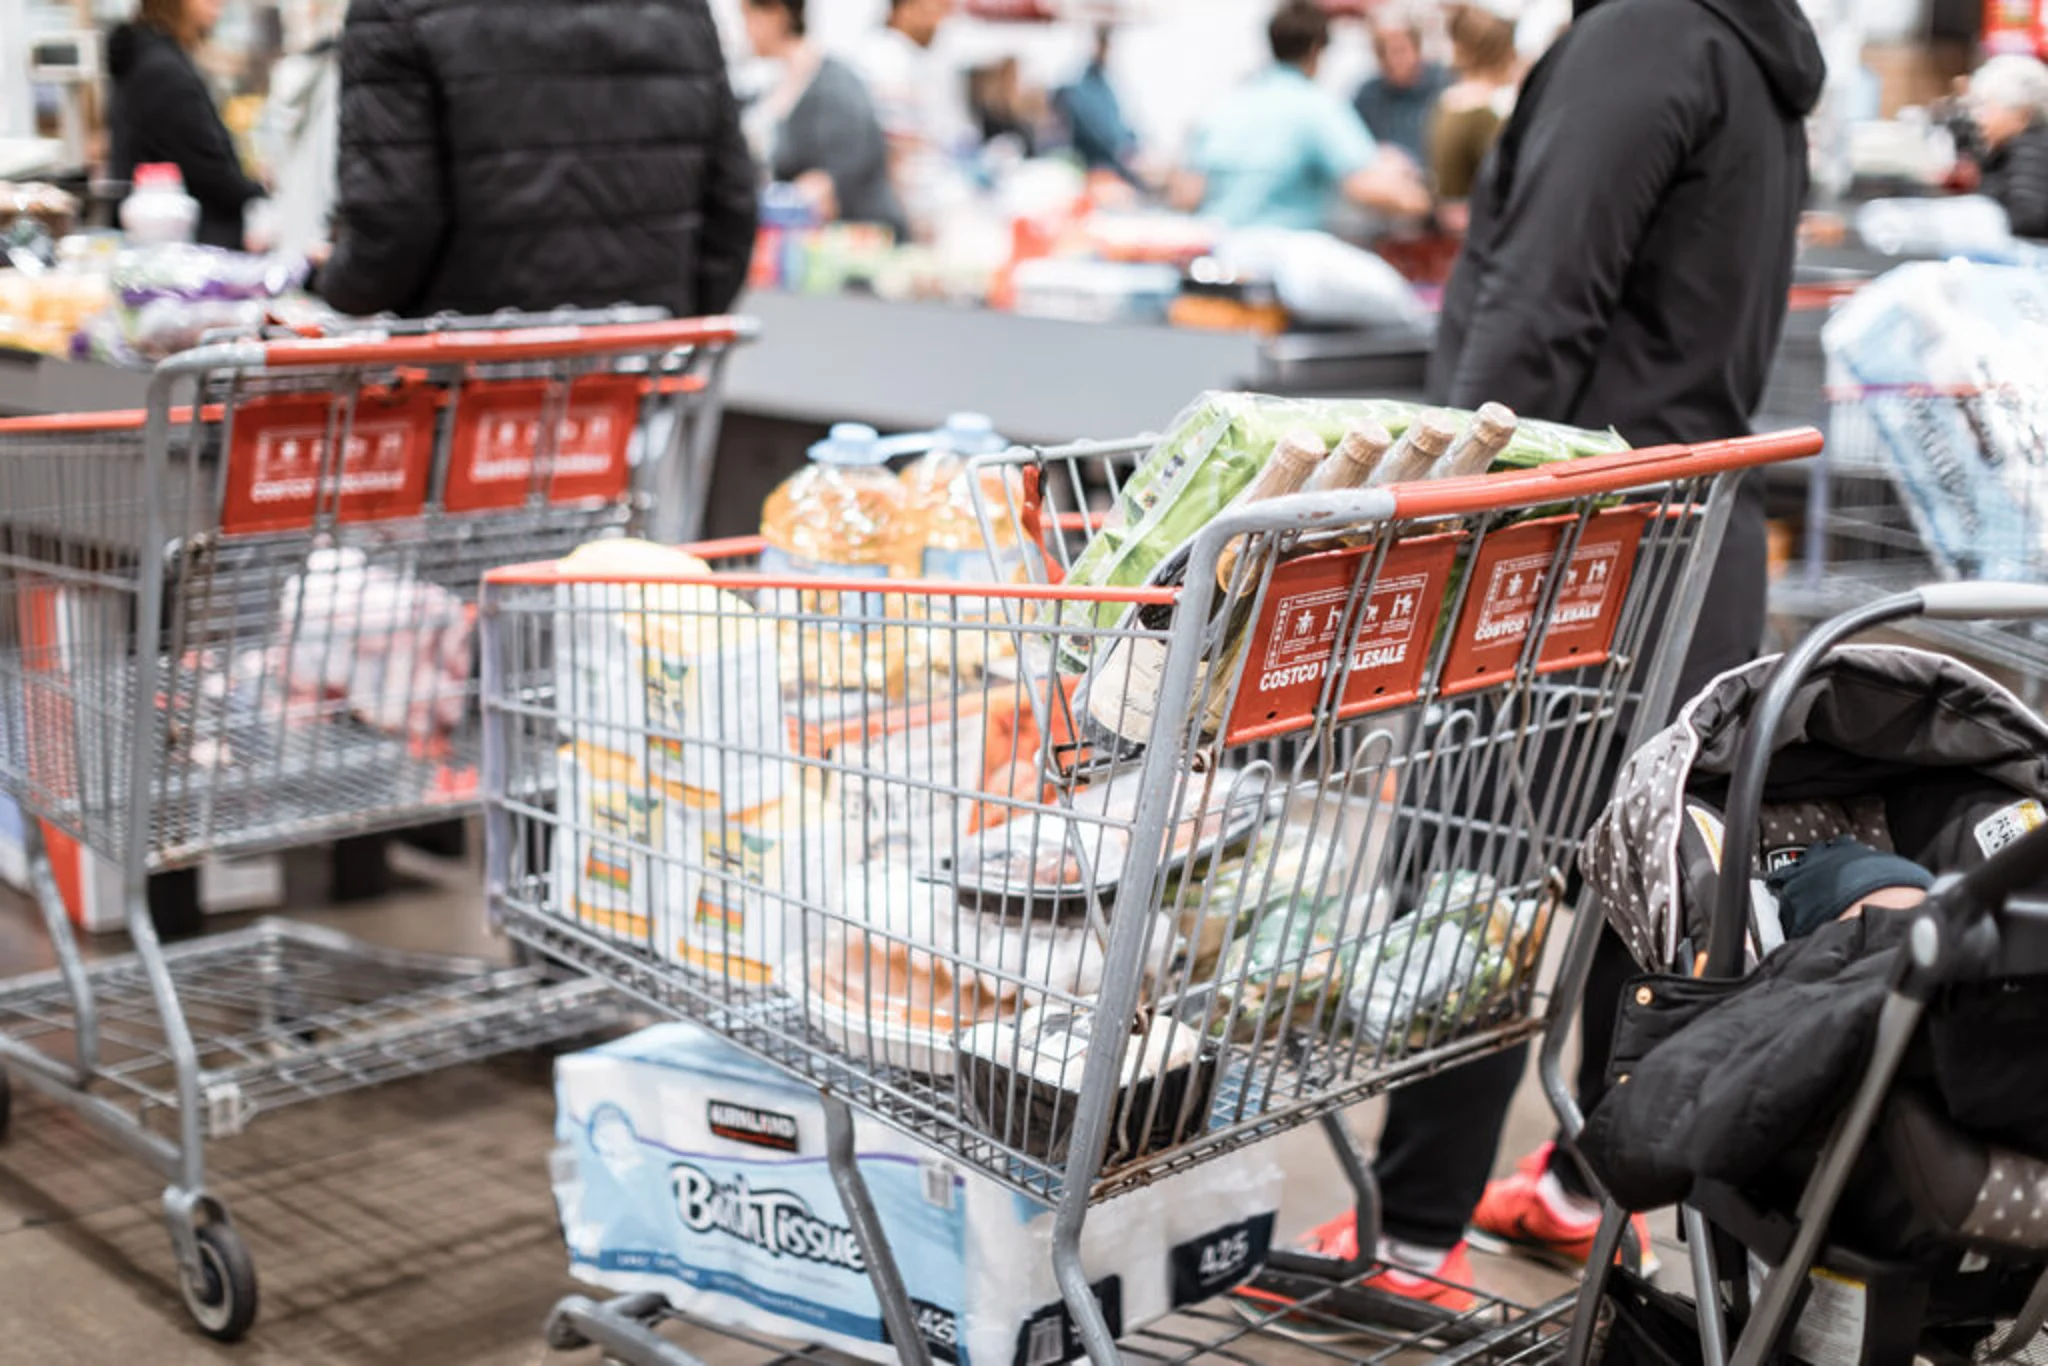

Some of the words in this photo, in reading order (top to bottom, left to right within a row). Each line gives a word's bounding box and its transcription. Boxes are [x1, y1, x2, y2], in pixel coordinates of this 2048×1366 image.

[1259, 661, 1319, 692] COSTCO
[1321, 643, 1408, 678] LESALE
[750, 1187, 868, 1272] Tissue
